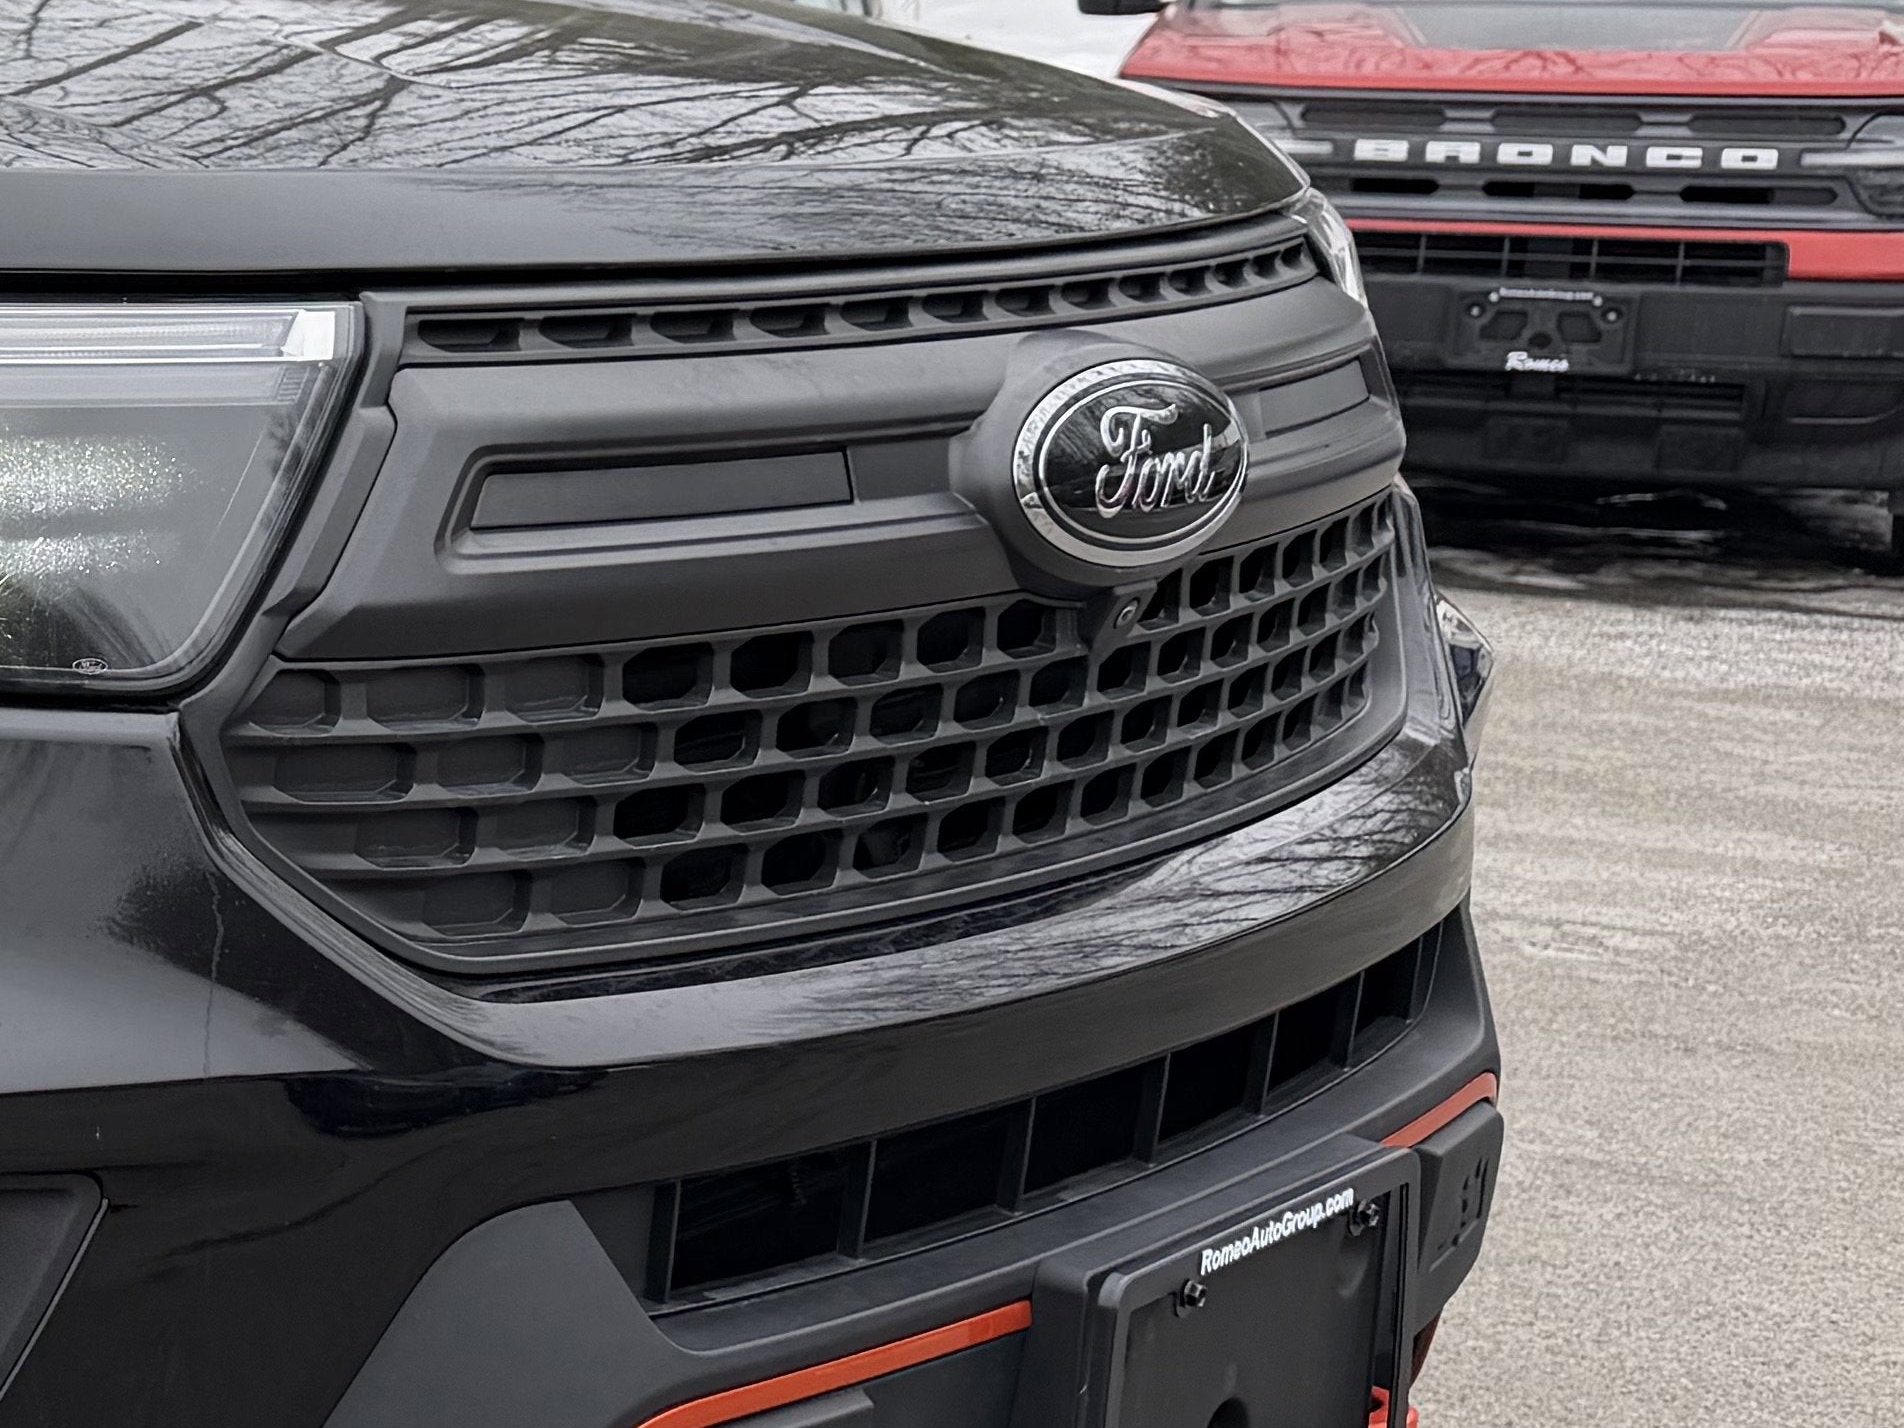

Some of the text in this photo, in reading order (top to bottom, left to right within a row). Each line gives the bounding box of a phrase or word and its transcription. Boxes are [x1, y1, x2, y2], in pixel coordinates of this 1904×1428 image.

[1353, 139, 1779, 170] BRONCO
[1095, 402, 1220, 519] Ford
[1200, 1188, 1355, 1276] RomeoAutoGroup.com
